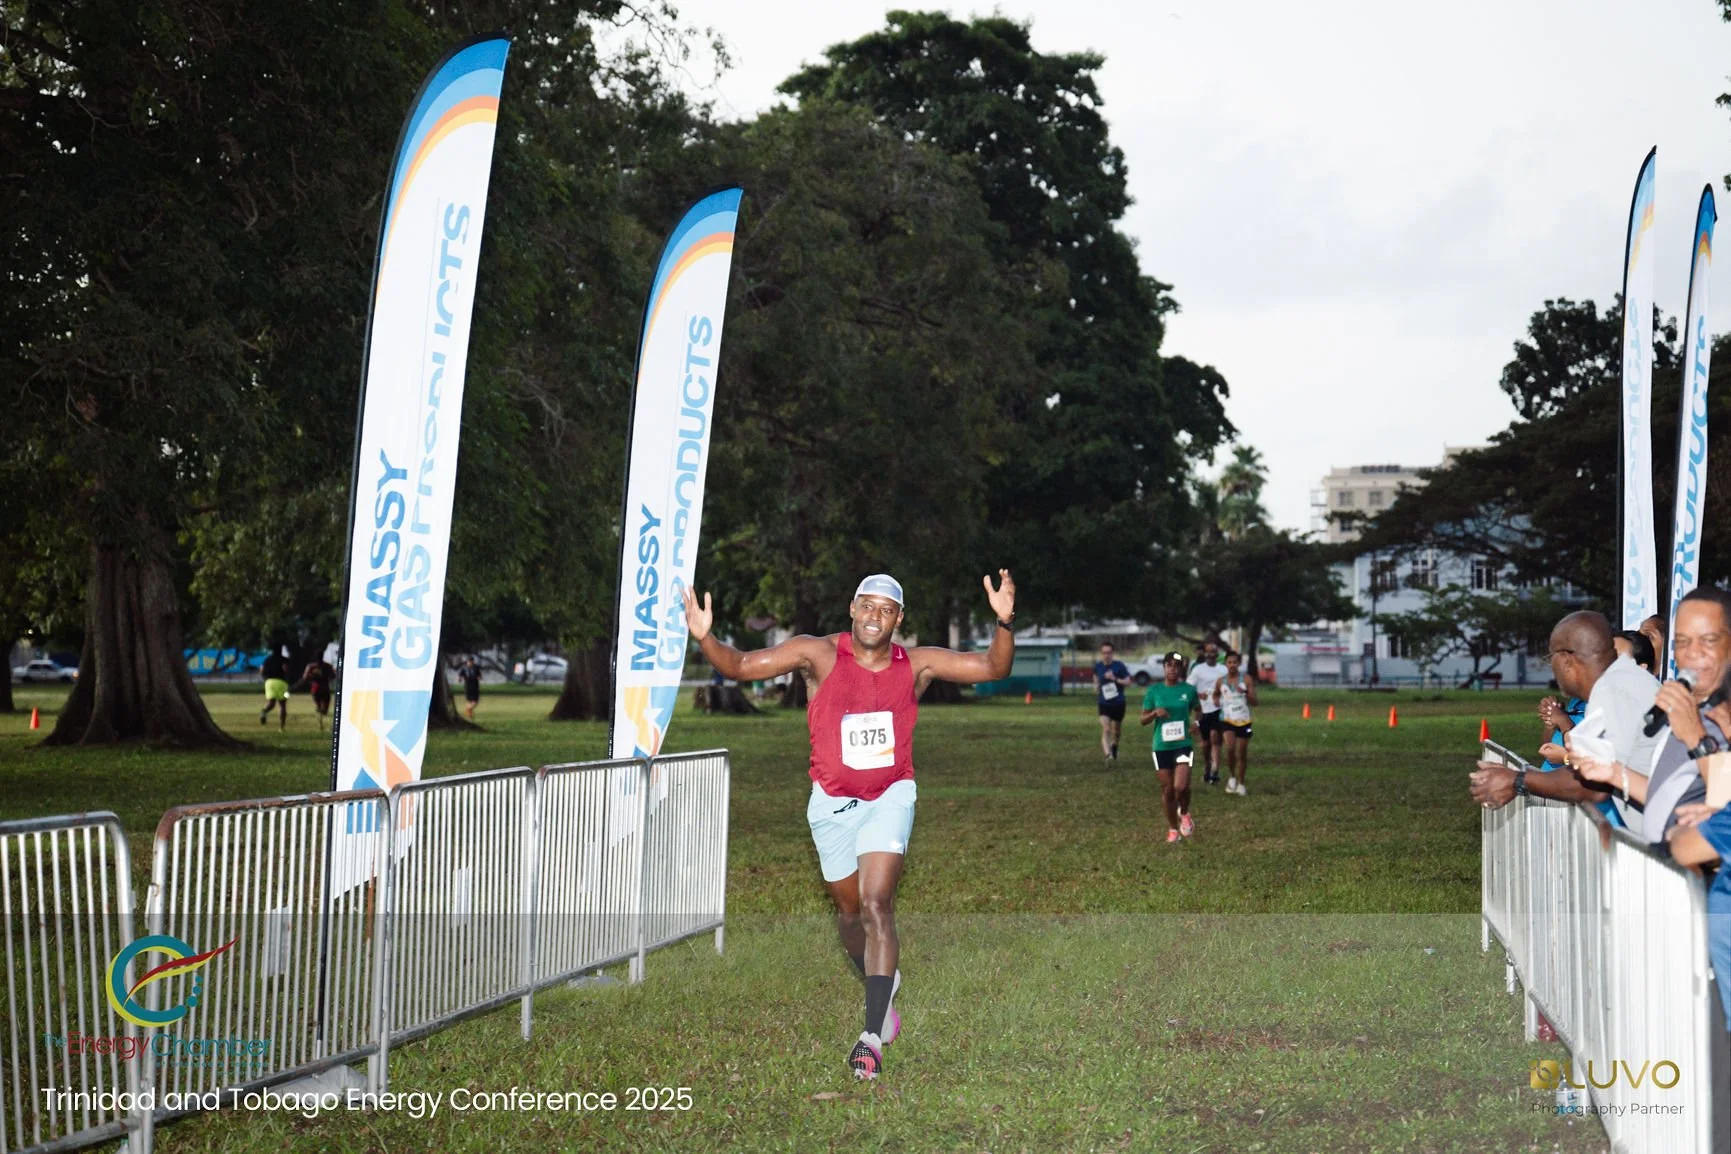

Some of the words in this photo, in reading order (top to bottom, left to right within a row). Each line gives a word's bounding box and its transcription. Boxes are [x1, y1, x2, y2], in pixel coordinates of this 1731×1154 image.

[358, 448, 408, 669] MASSY
[390, 543, 433, 670] GAS
[631, 503, 661, 671] MASSY
[849, 728, 887, 747] 0375
